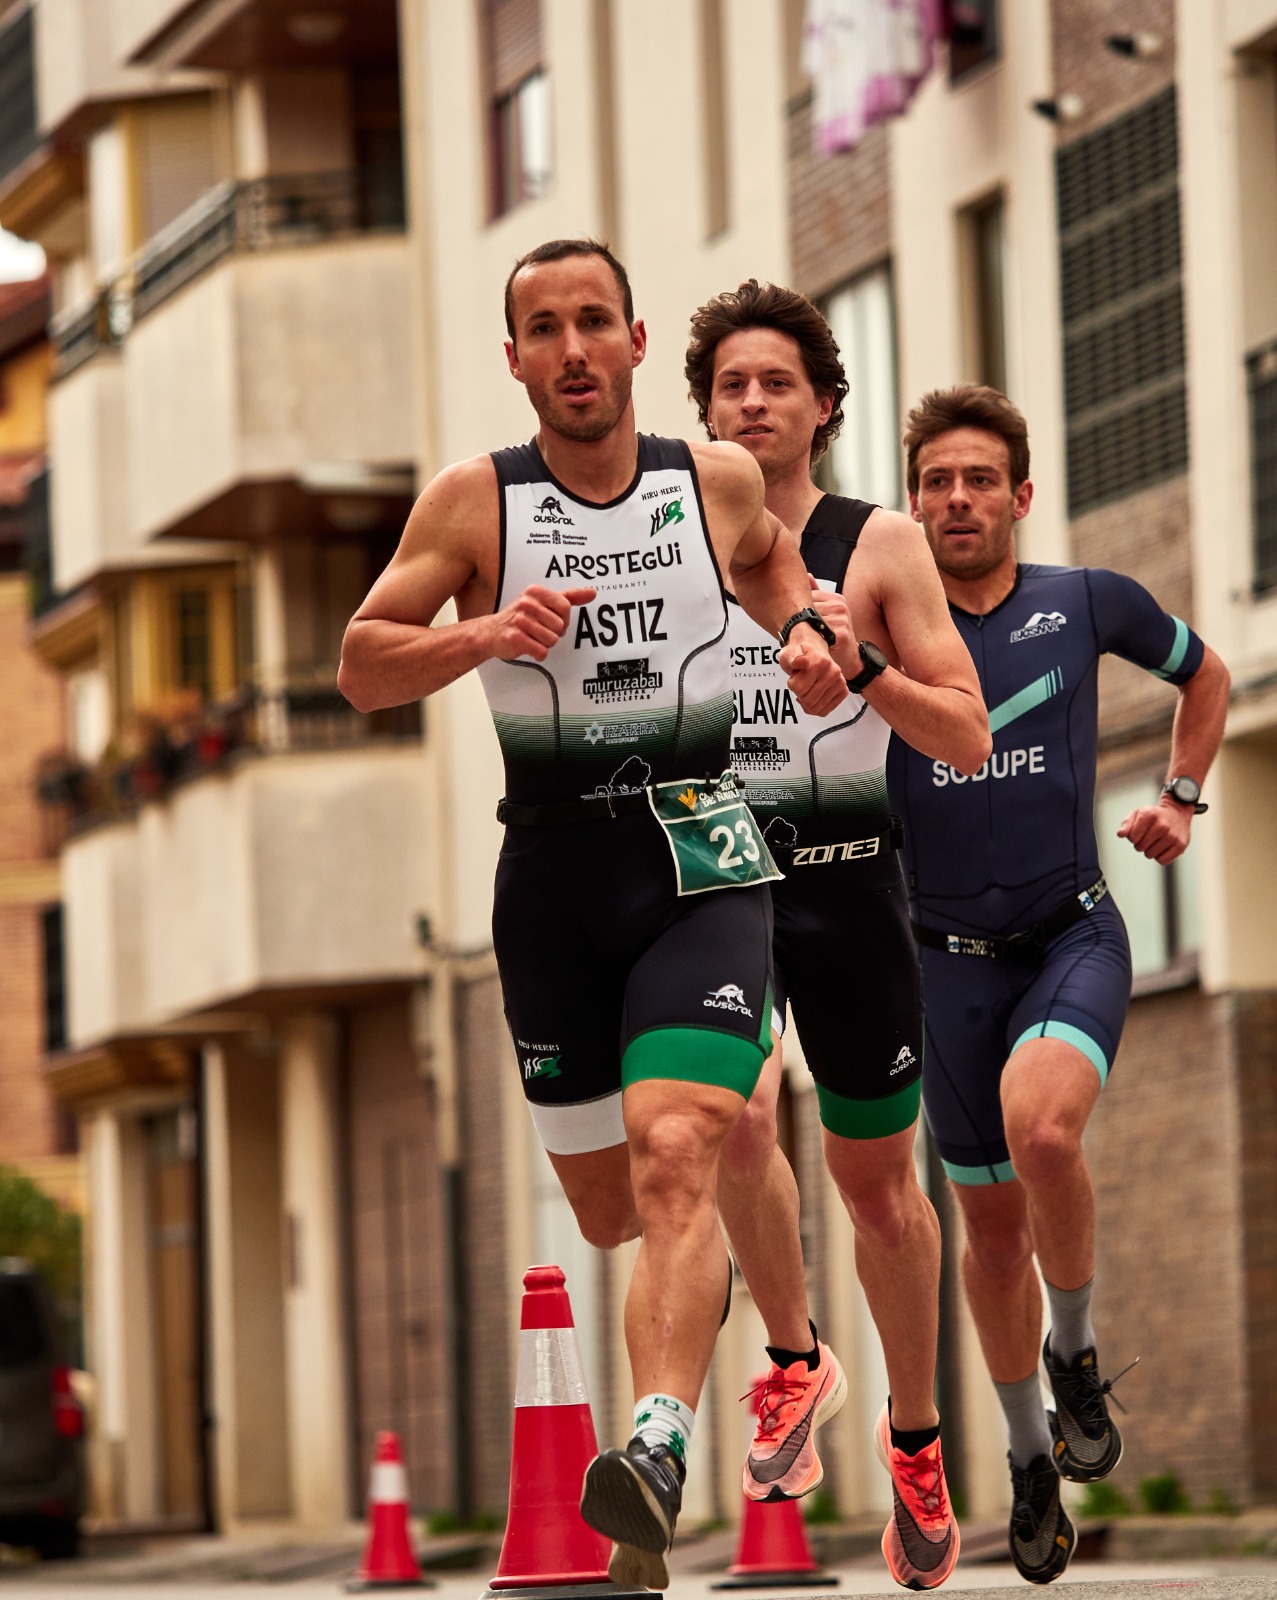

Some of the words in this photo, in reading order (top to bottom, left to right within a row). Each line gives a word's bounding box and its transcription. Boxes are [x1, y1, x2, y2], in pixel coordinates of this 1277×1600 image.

[533, 515, 576, 526] austral
[585, 580, 647, 592] STAURANTE
[574, 598, 668, 650] ASTIZ
[585, 671, 661, 694] muruzabal
[595, 694, 651, 704] BICICLETAS
[709, 819, 760, 870] 23
[793, 836, 880, 866] ZONE3
[703, 999, 753, 1018] austral
